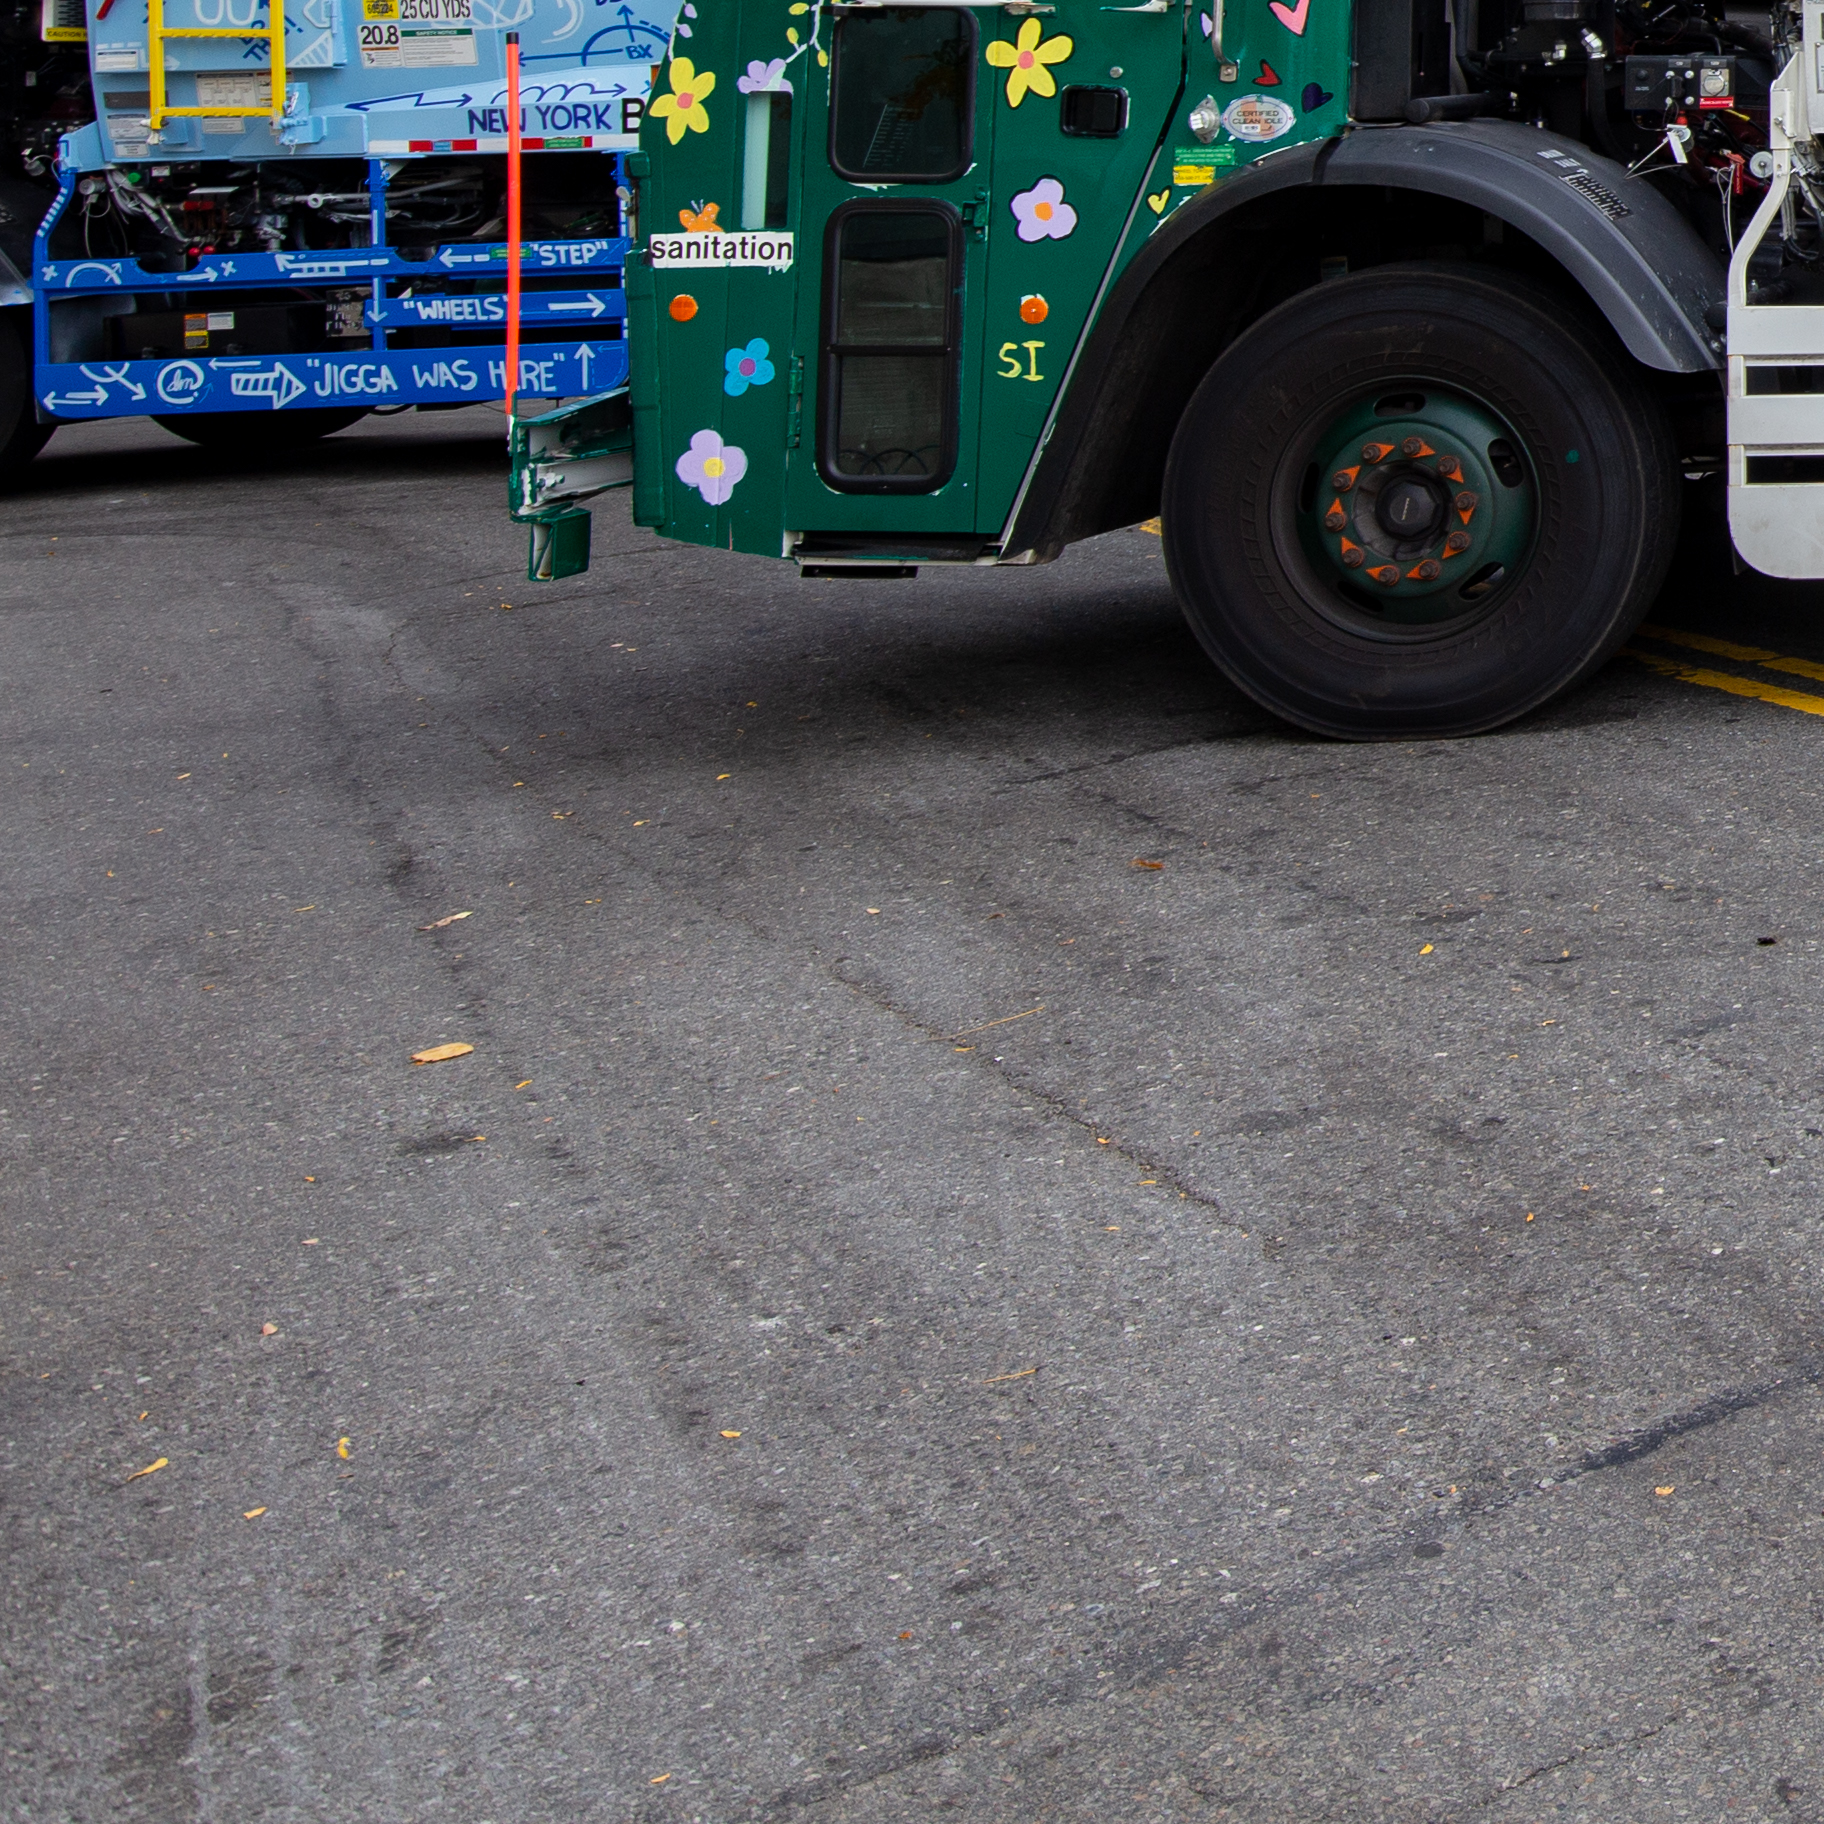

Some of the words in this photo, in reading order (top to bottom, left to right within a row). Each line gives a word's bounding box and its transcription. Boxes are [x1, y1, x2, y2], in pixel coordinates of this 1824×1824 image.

[360, 25, 399, 45] 20.8
[535, 102, 613, 131] YORK
[533, 241, 609, 266] "STEP"
[652, 234, 792, 260] sanitation
[412, 359, 478, 391] WAS
[488, 352, 566, 393] HRE"
[997, 340, 1045, 381] SI
